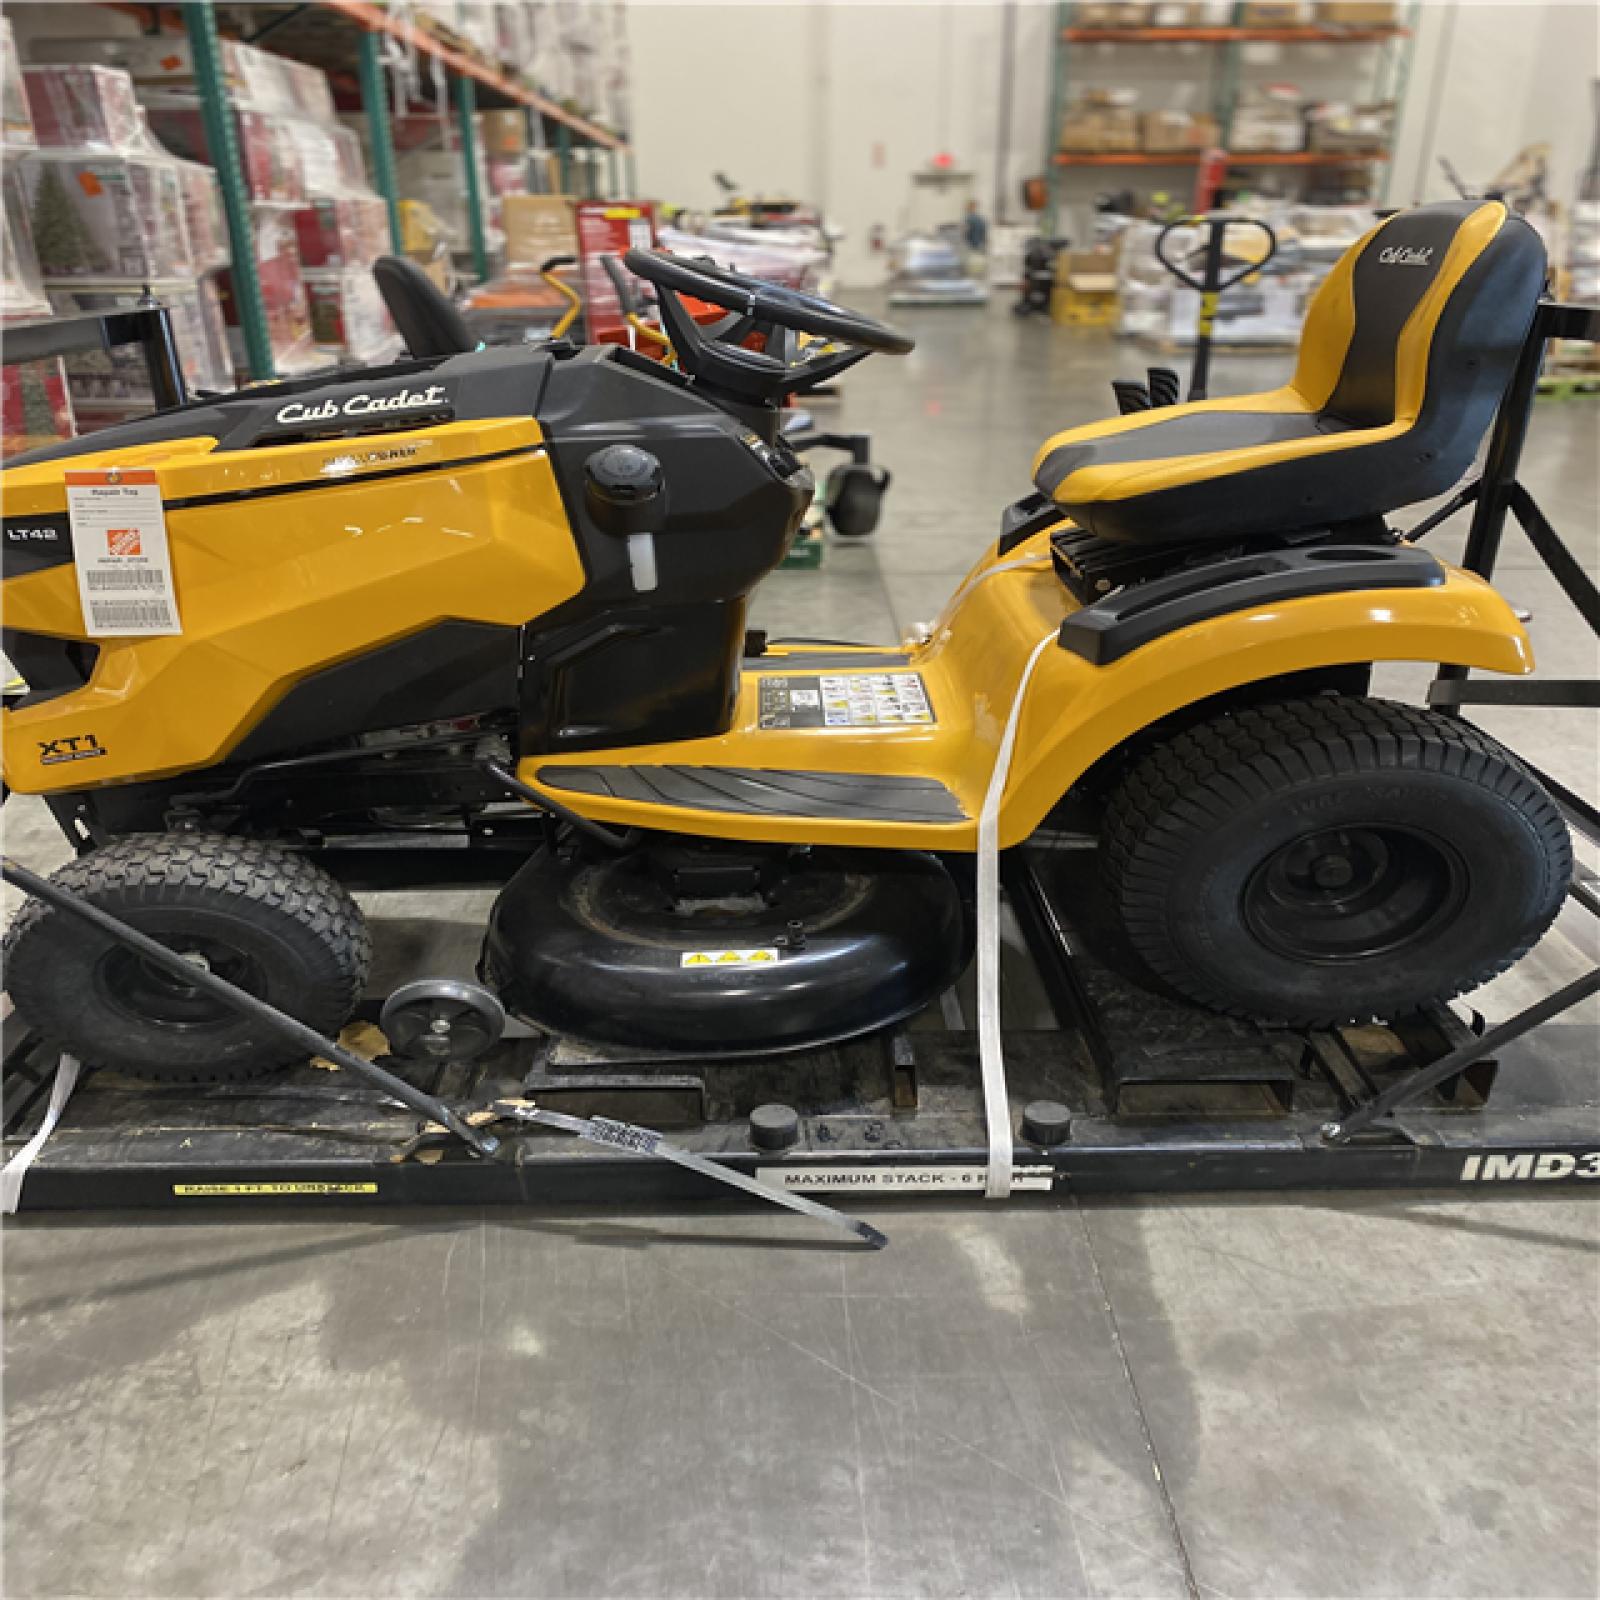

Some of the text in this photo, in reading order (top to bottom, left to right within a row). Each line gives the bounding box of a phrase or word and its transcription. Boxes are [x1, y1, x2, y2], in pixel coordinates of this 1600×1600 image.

[275, 384, 446, 424] Cub Cadet
[784, 1173, 877, 1184] MAXIMUM
[882, 1173, 944, 1184] STACK
